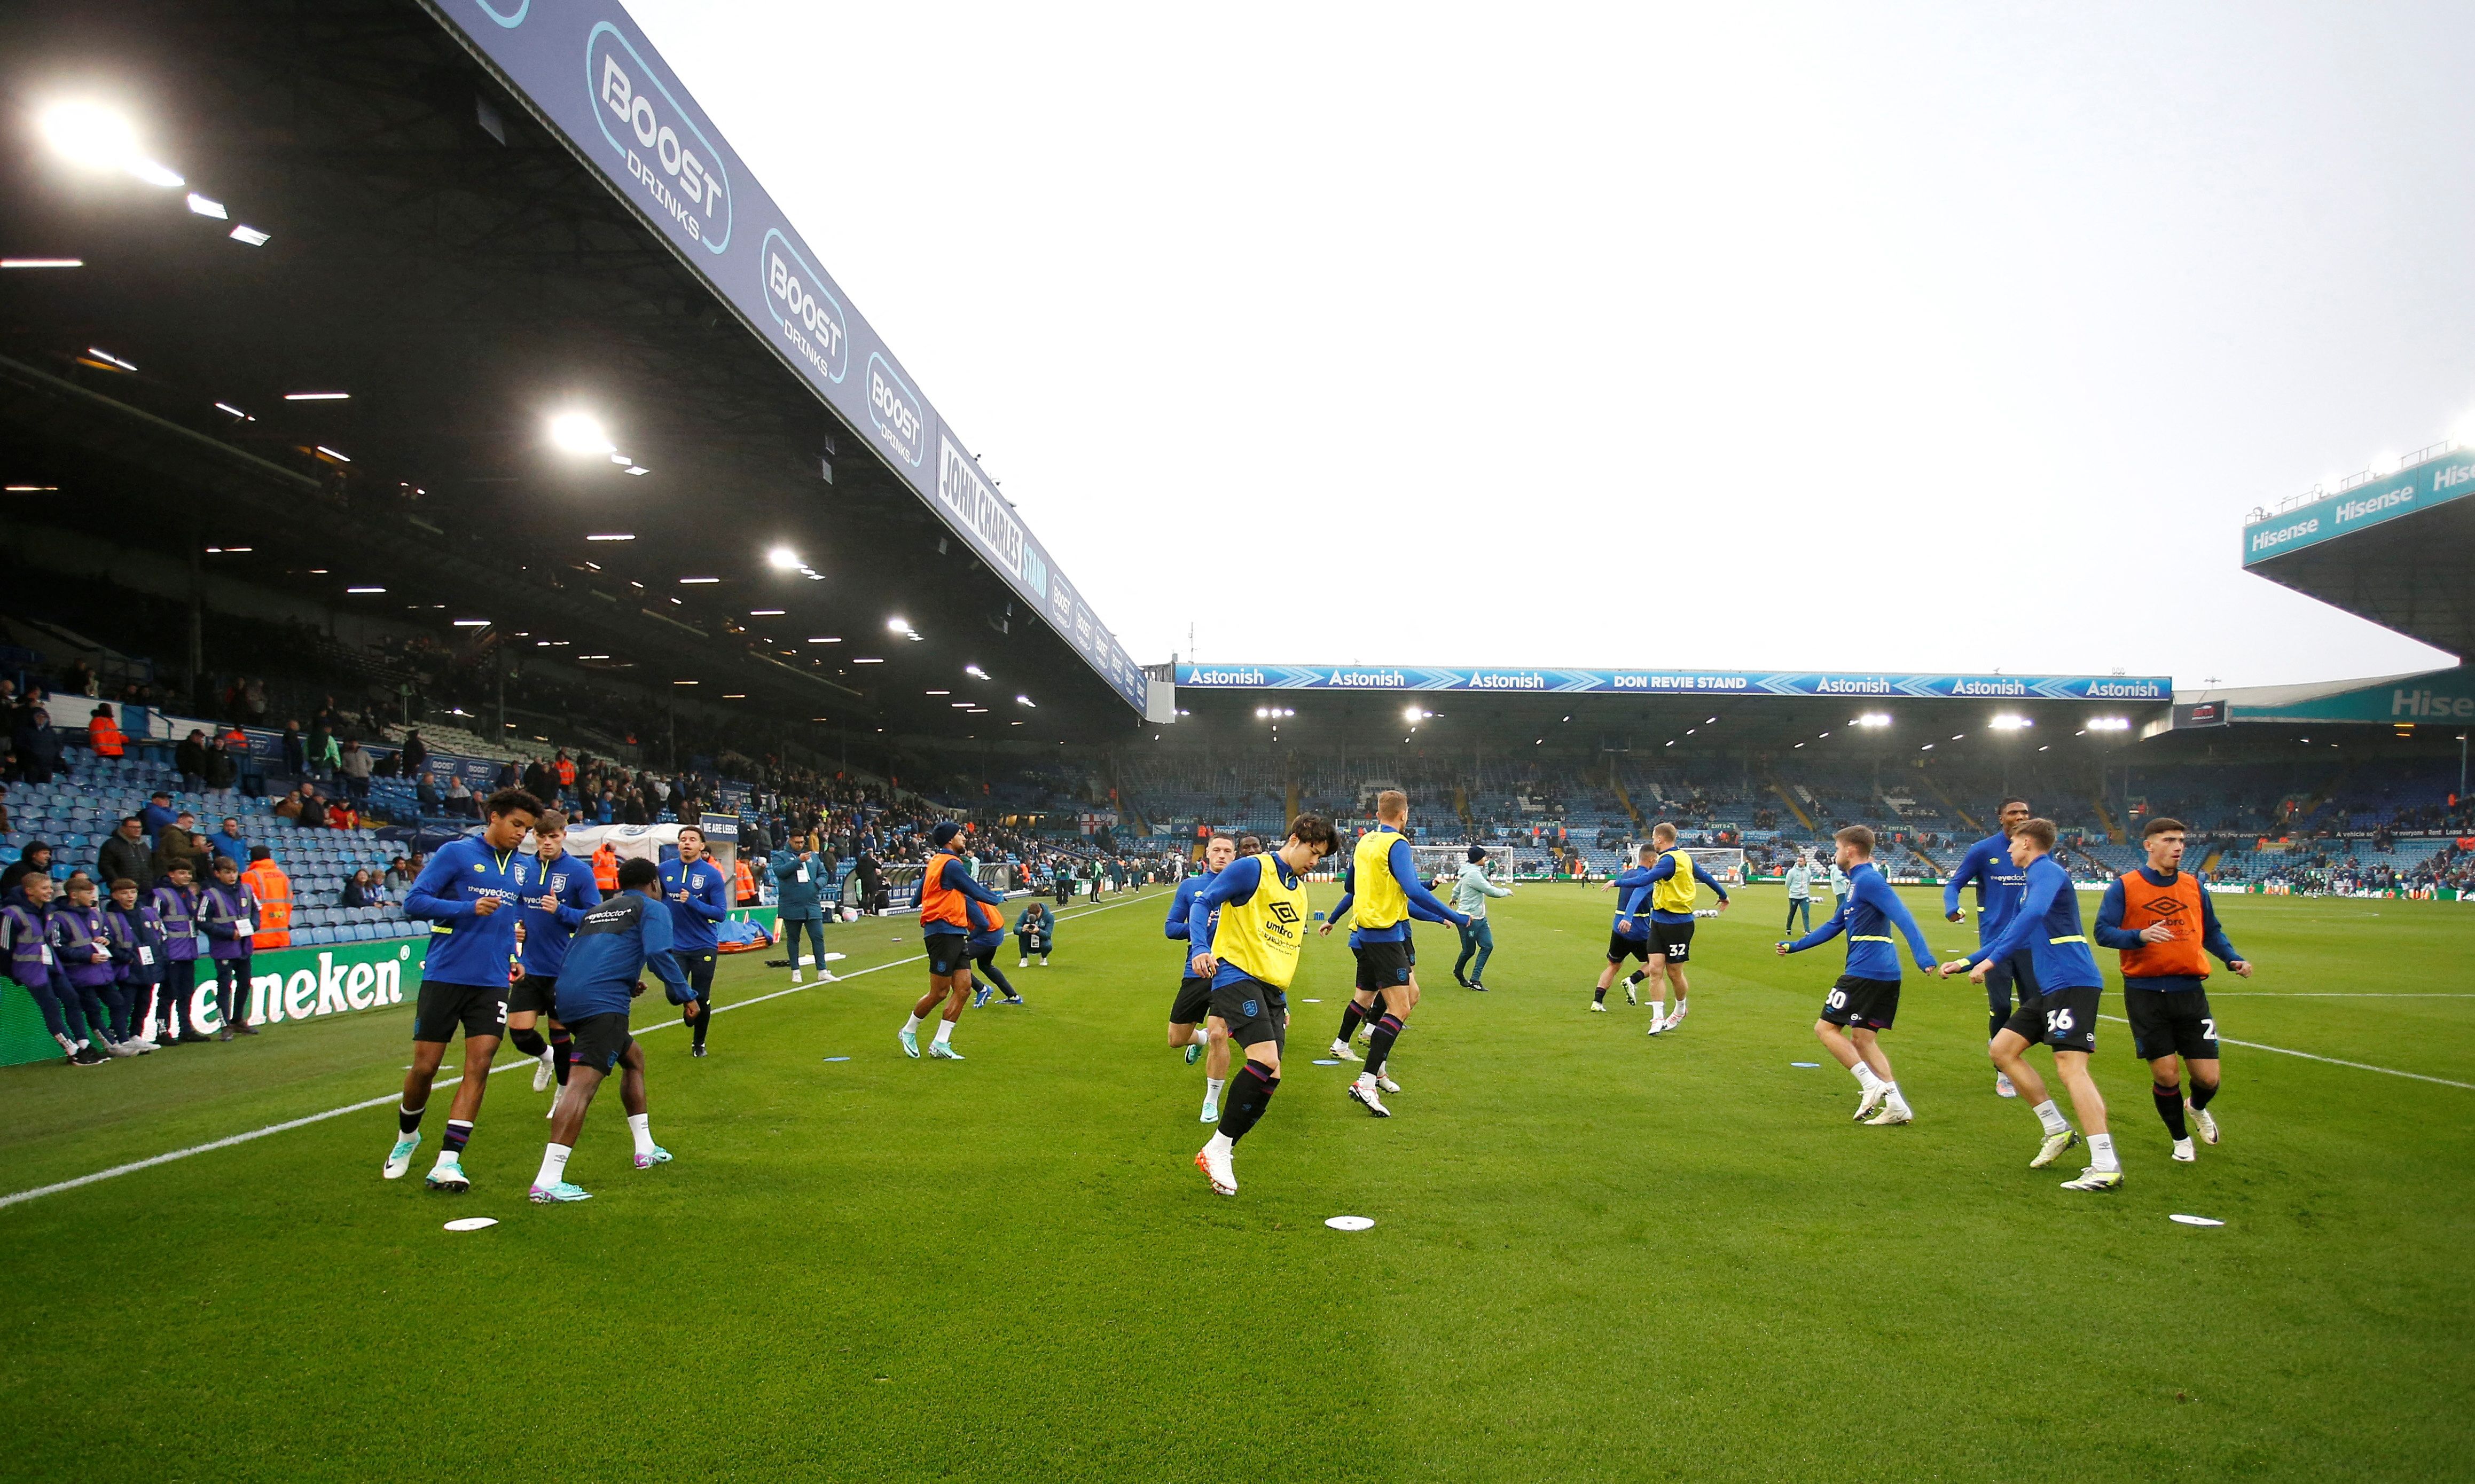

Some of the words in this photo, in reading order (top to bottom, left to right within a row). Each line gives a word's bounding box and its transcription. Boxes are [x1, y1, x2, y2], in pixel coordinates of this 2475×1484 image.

[601, 54, 722, 218] BOOST
[627, 150, 701, 241] DRINKS
[770, 252, 842, 357] BOOST
[784, 319, 828, 377] DRINKS
[872, 371, 920, 445] BOOST
[881, 426, 911, 465] DRINKS
[2335, 485, 2414, 524] Hisense
[943, 449, 977, 525] JOHN
[978, 489, 1021, 572] CHARLES
[1023, 542, 1047, 599] STAND
[2251, 516, 2319, 552] Hisense
[1054, 585, 1070, 616] BOOST
[1077, 612, 1091, 640] BOOST
[1188, 668, 1264, 686] Astonish
[1328, 669, 1405, 687] Astonish
[1468, 671, 1544, 689] Astonish
[1614, 676, 1647, 688] DON
[1651, 676, 1694, 688] REVIE
[1697, 676, 1747, 689] STAND
[1816, 677, 1890, 694] Astonish
[1951, 678, 2025, 695] Astonish
[2085, 680, 2159, 697] Astonish
[432, 761, 455, 770] BOOST
[468, 765, 489, 774] BOOST
[703, 822, 712, 833] WE
[712, 823, 722, 834] ARE
[723, 824, 738, 835] LEEDS
[1675, 830, 1708, 839] Astonh
[1266, 920, 1293, 939] umbro
[1669, 943, 1686, 956] 32
[1825, 987, 1846, 1009] 30
[2046, 1008, 2073, 1032] 36
